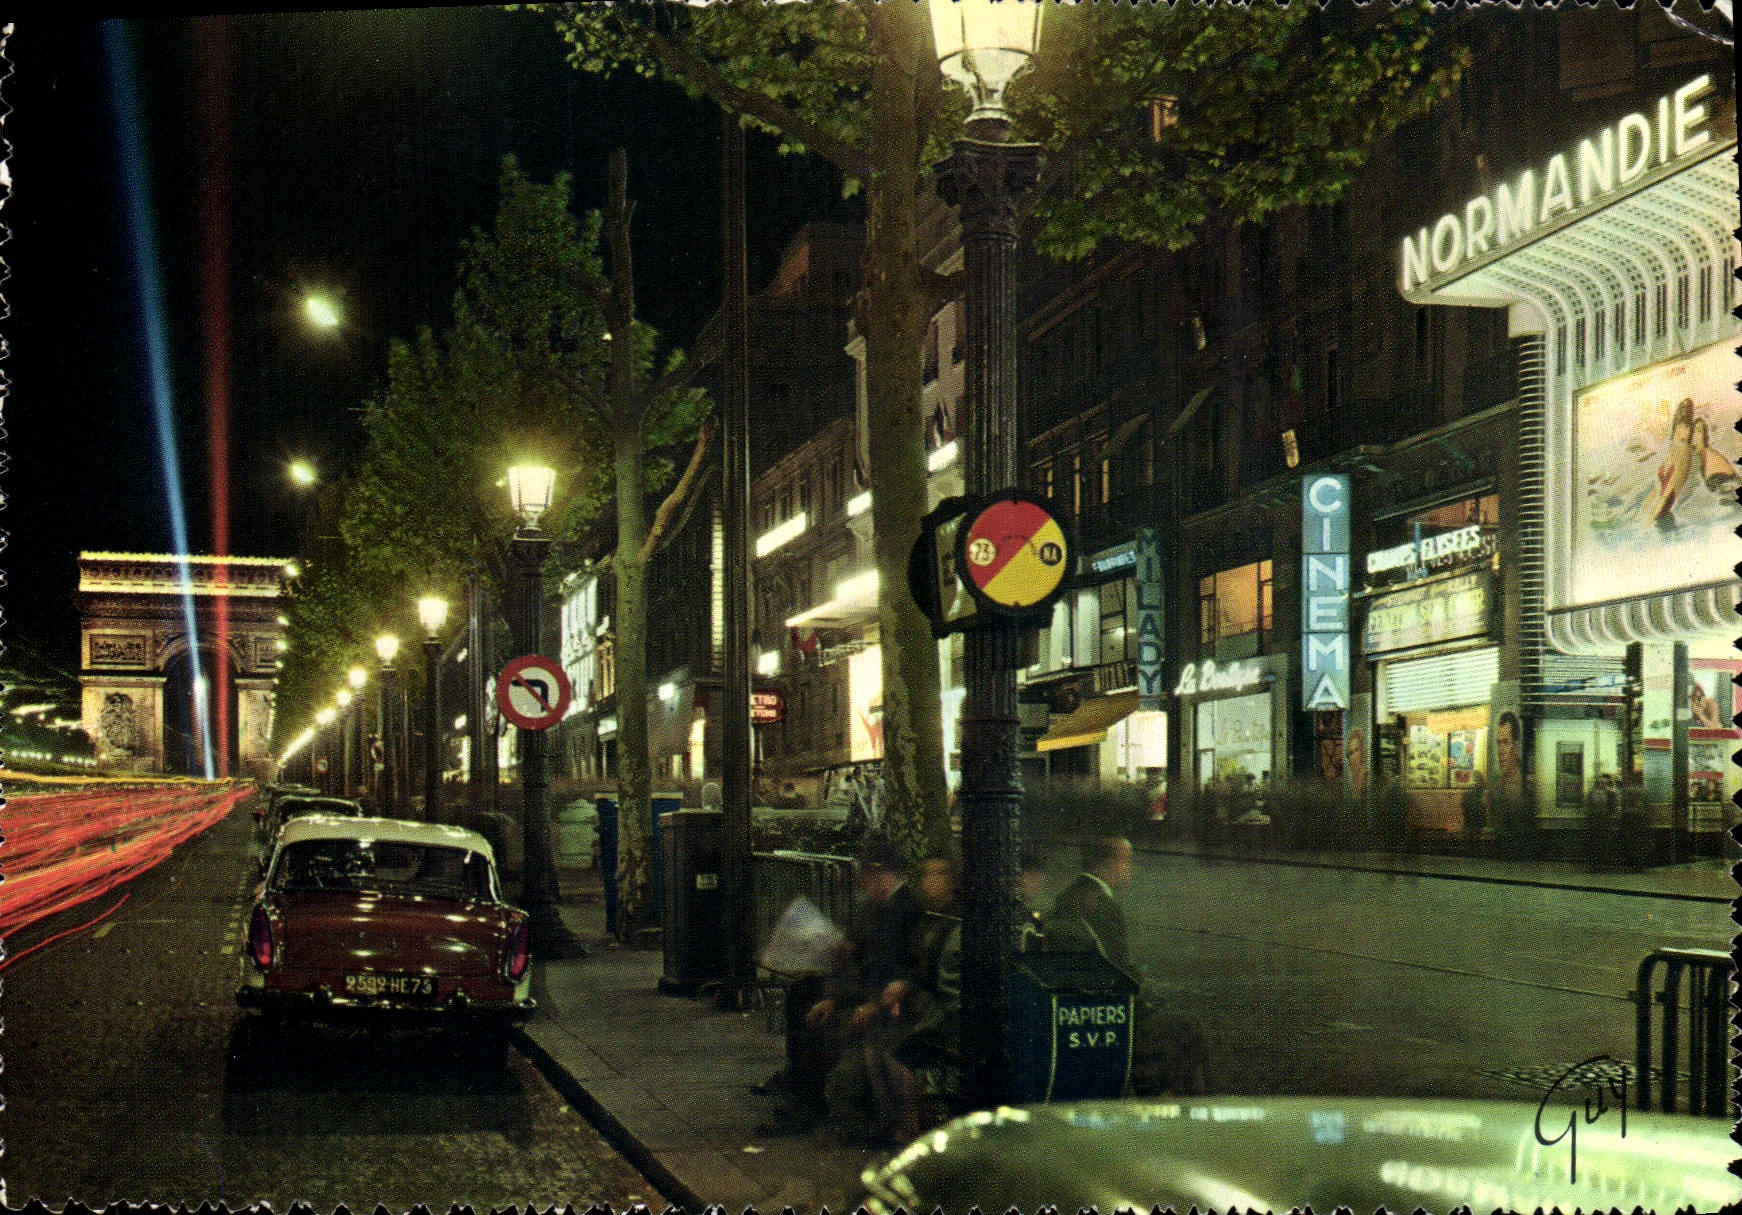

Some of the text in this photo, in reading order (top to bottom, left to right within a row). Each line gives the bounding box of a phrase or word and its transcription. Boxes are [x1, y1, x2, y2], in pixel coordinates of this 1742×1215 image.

[1402, 75, 1711, 292] NORMANDIE
[1136, 528, 1162, 694] MILADY
[1305, 477, 1348, 710] CINEMA
[1058, 1005, 1126, 1025] PAPIERS
